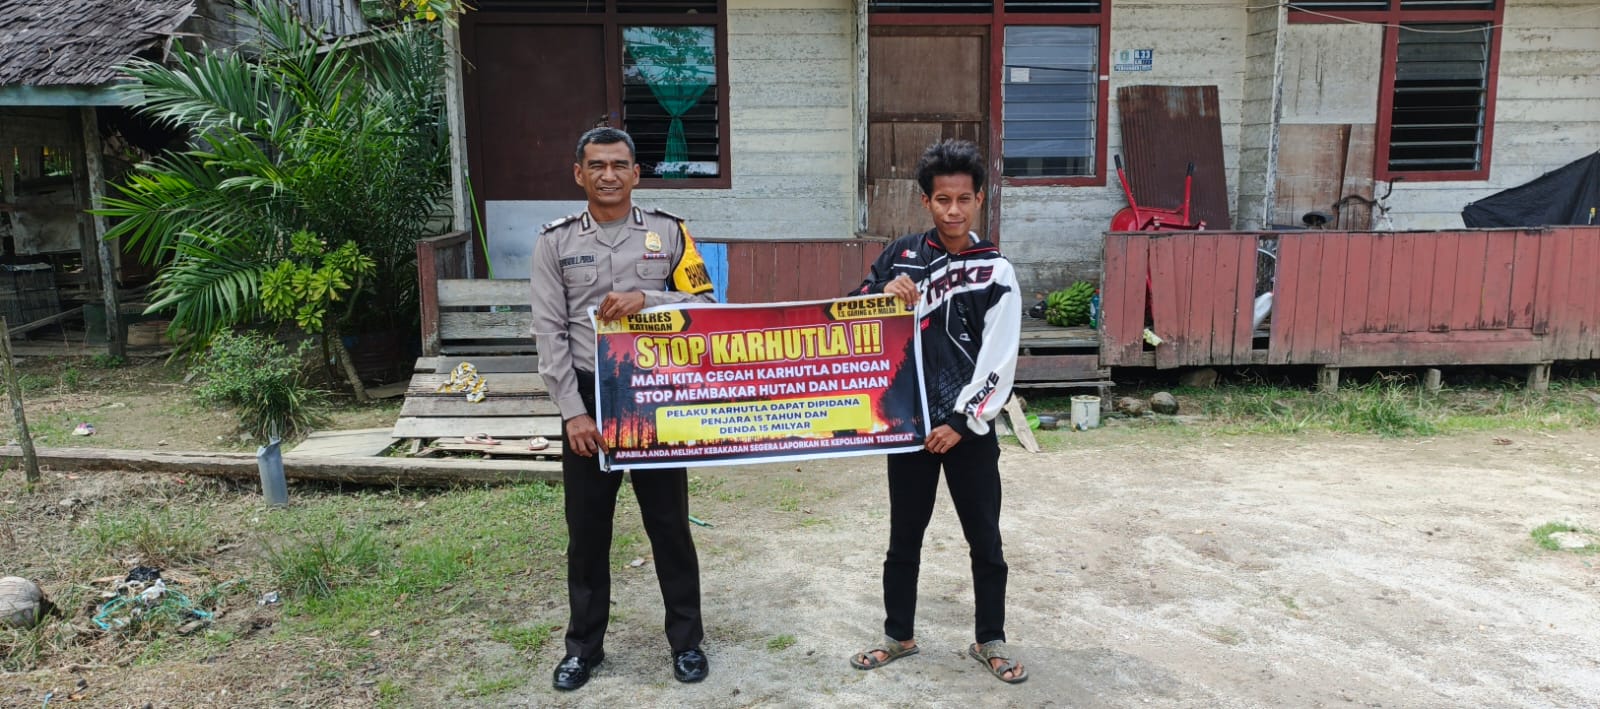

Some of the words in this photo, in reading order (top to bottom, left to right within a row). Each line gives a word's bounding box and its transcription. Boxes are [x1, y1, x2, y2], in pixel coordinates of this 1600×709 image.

[837, 296, 896, 311] POLSEK
[627, 311, 672, 323] POLRES
[629, 323, 673, 332] KATINGAN
[636, 335, 706, 368] STOP
[710, 325, 850, 365] KARHUTLA
[852, 323, 881, 354] !!!
[631, 373, 669, 387] MARI
[672, 372, 704, 385] KITA
[706, 370, 754, 383] CEGAH
[757, 363, 828, 379] KARHUTLA
[832, 360, 890, 375] DENGAN
[635, 391, 673, 403] STOP
[675, 386, 756, 400] MEMBAKAR
[759, 381, 806, 396] HUTAN
[809, 379, 839, 392] DAN
[842, 376, 889, 390] LAHAN
[667, 408, 708, 417] PELAKU
[711, 405, 768, 415] KARHUTLA
[770, 402, 805, 411] DAPAT
[808, 398, 860, 408] DIPIDANA
[701, 416, 751, 426] PENJARA
[753, 414, 763, 422] 15
[766, 412, 802, 421] TAHUN
[804, 410, 827, 419] DAN
[720, 425, 756, 435] DENDA
[771, 421, 811, 430] MILYAR
[616, 451, 648, 459] APABILA
[671, 448, 703, 457] MELIHAT
[704, 445, 748, 455] KEBAKARAN
[750, 443, 779, 452] SEGERA
[779, 440, 820, 449] LAPORKAN
[820, 439, 830, 447] KE
[831, 437, 874, 446] KEPOLISIAN
[876, 433, 914, 443] TERDEKAT
